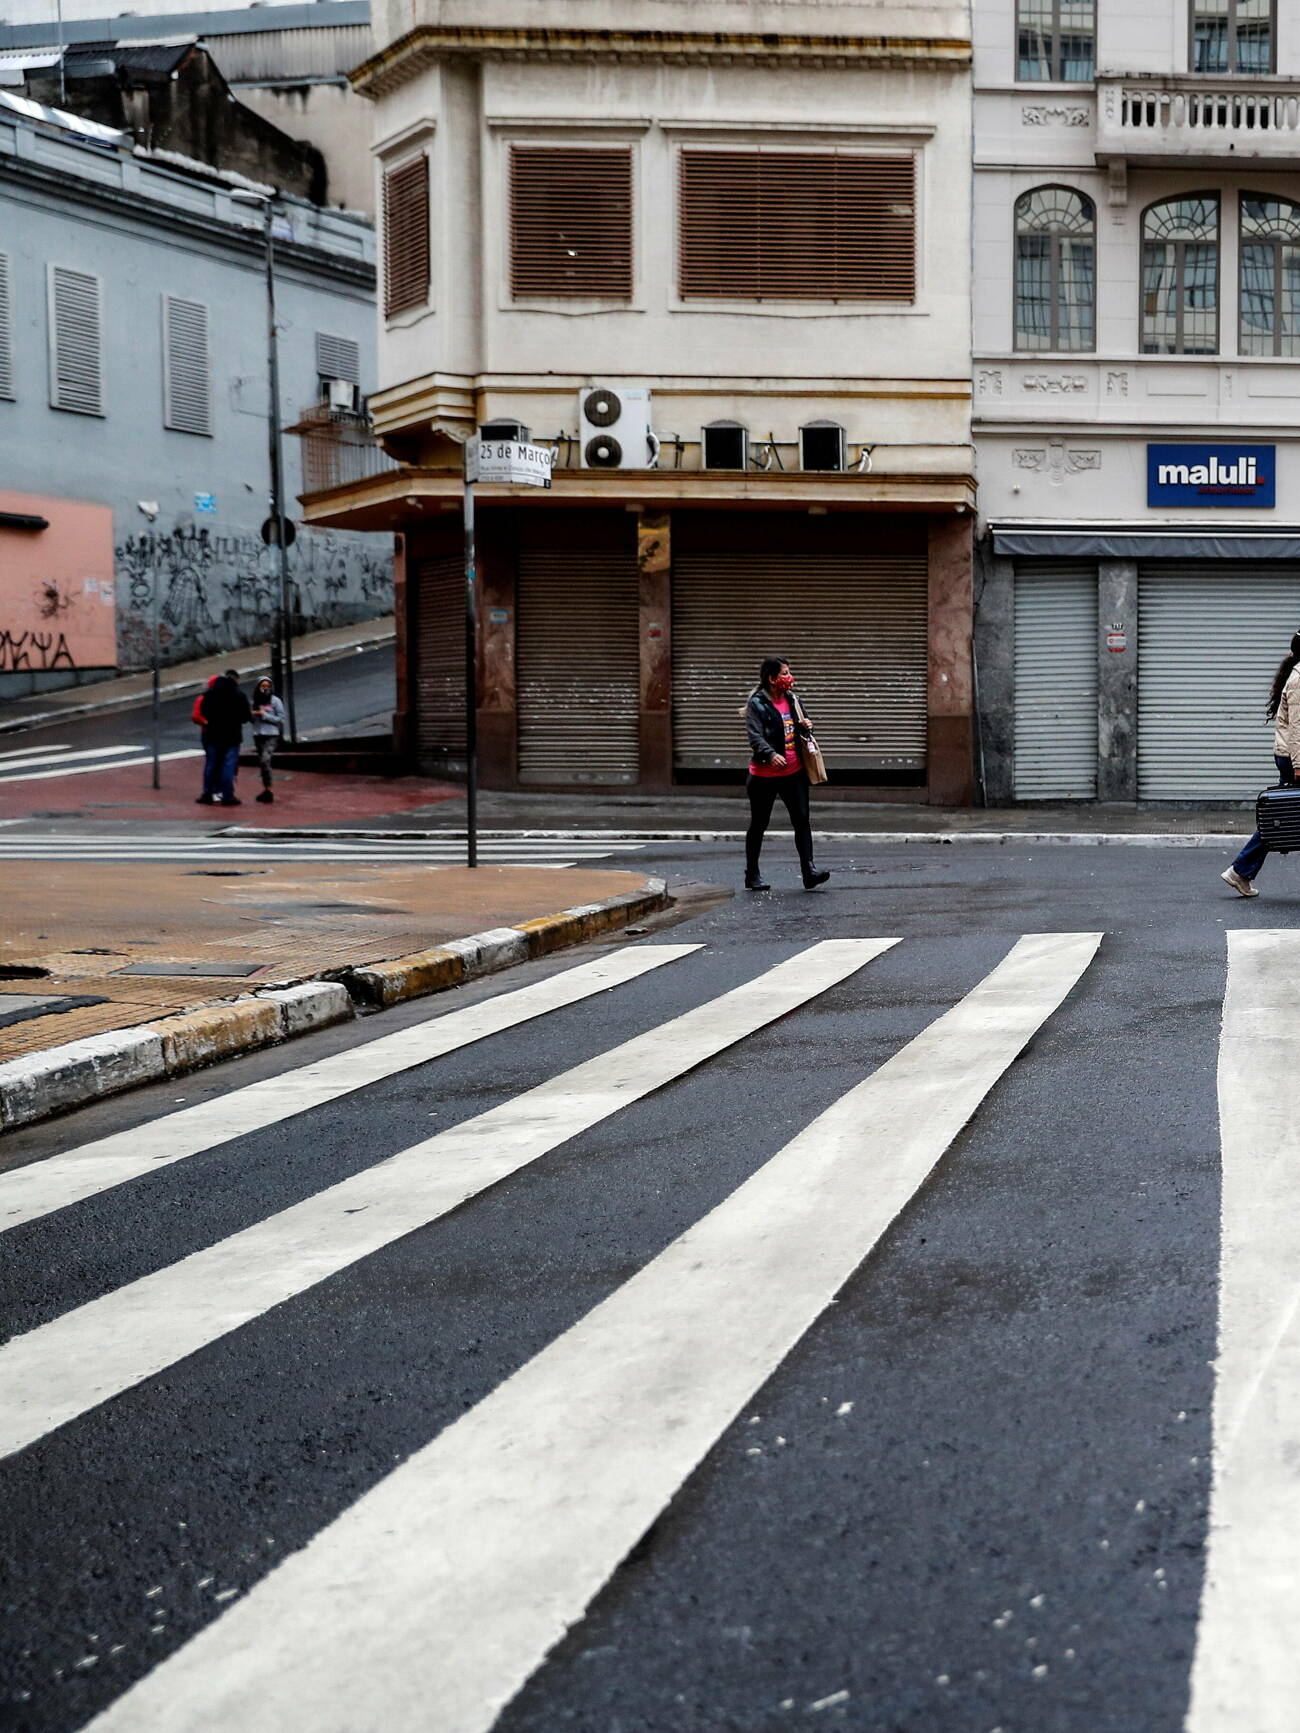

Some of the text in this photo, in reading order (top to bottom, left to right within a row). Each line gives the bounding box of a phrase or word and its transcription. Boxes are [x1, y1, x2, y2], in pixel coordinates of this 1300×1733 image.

[480, 444, 492, 459] 25
[497, 443, 512, 459] de
[518, 445, 550, 467] Março
